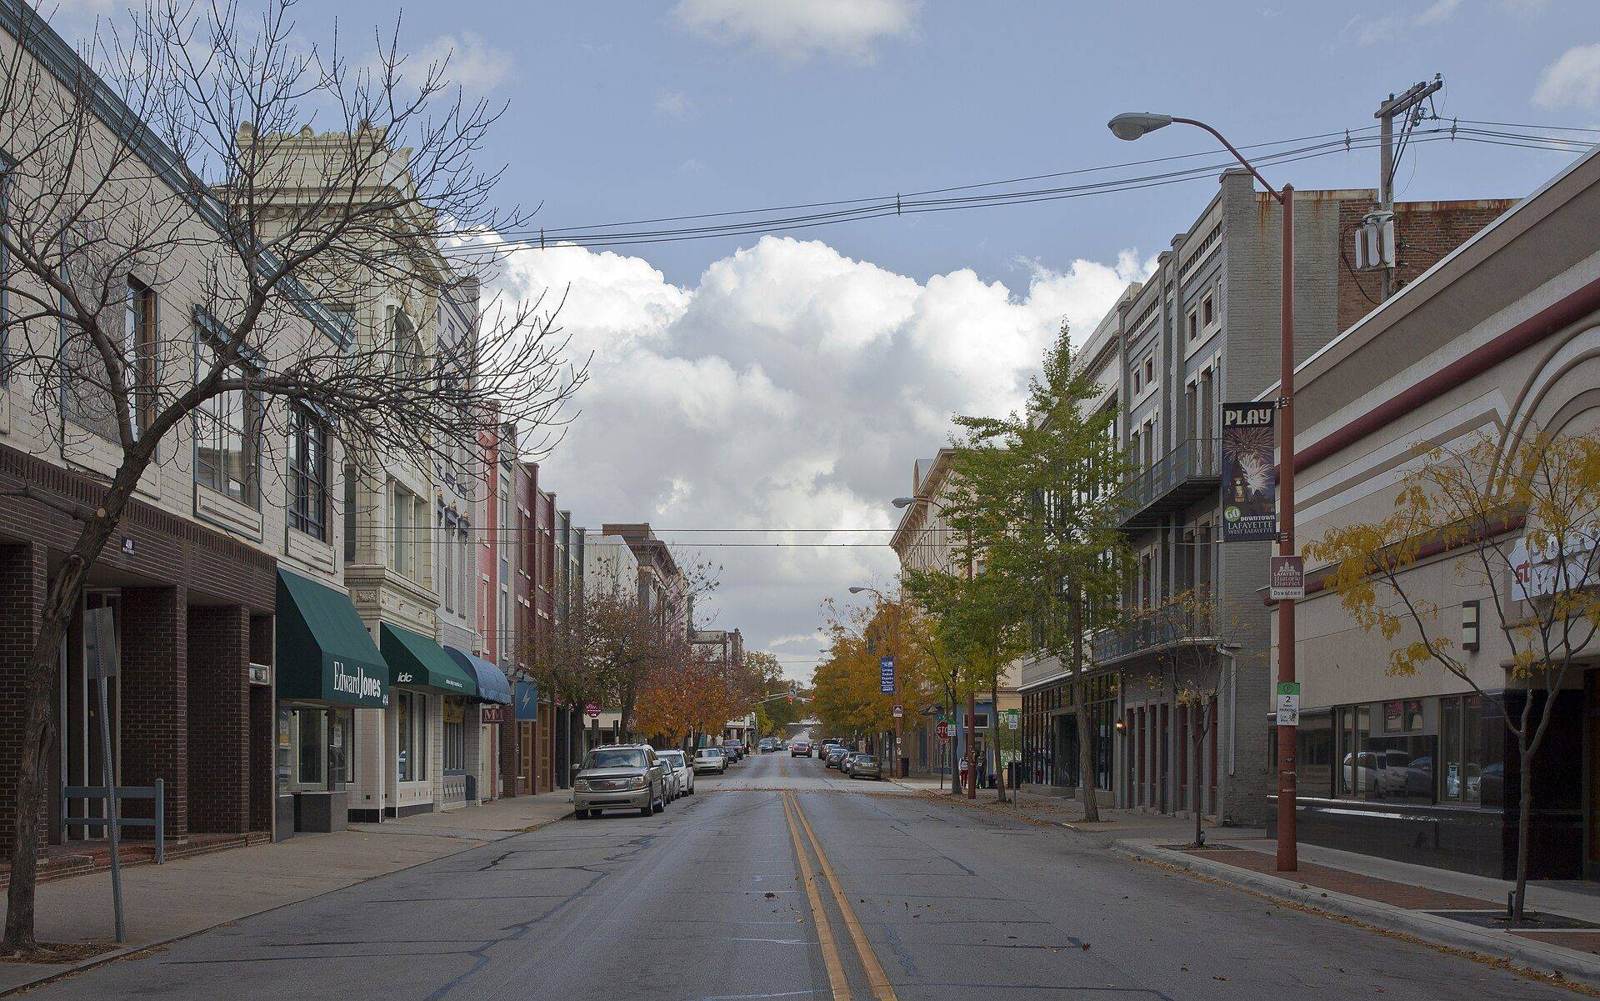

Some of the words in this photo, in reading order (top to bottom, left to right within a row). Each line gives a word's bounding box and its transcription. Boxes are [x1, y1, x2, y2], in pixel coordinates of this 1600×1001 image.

[1225, 409, 1272, 426] PLAY
[1228, 521, 1273, 529] LAFAYETTE
[334, 661, 360, 693] Edward
[359, 667, 381, 699] Jones
[397, 672, 413, 682] idc
[1285, 695, 1292, 703] 2
